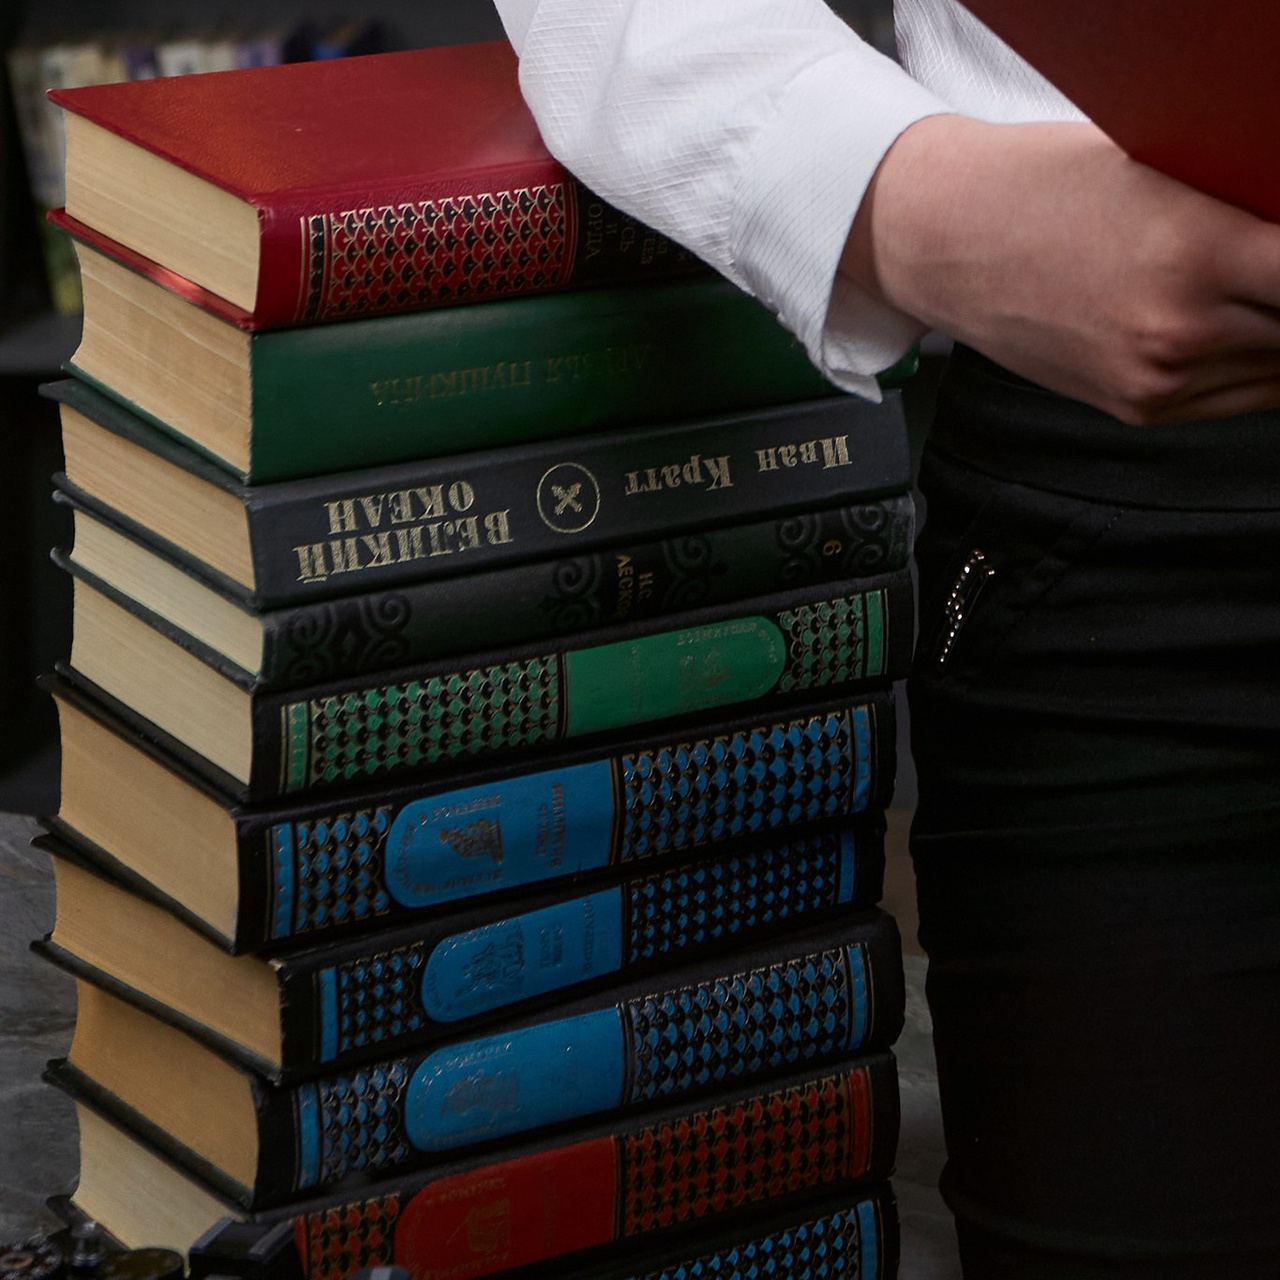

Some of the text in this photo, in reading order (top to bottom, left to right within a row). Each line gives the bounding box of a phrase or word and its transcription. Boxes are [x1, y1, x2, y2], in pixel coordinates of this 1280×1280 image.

[585, 203, 604, 260] ОРДА
[370, 359, 532, 407] ПУШКИНА
[624, 434, 853, 496] Иван Кратт
[323, 479, 475, 535] ОКЕАН
[293, 507, 514, 583] ВЕЛИКИЙ
